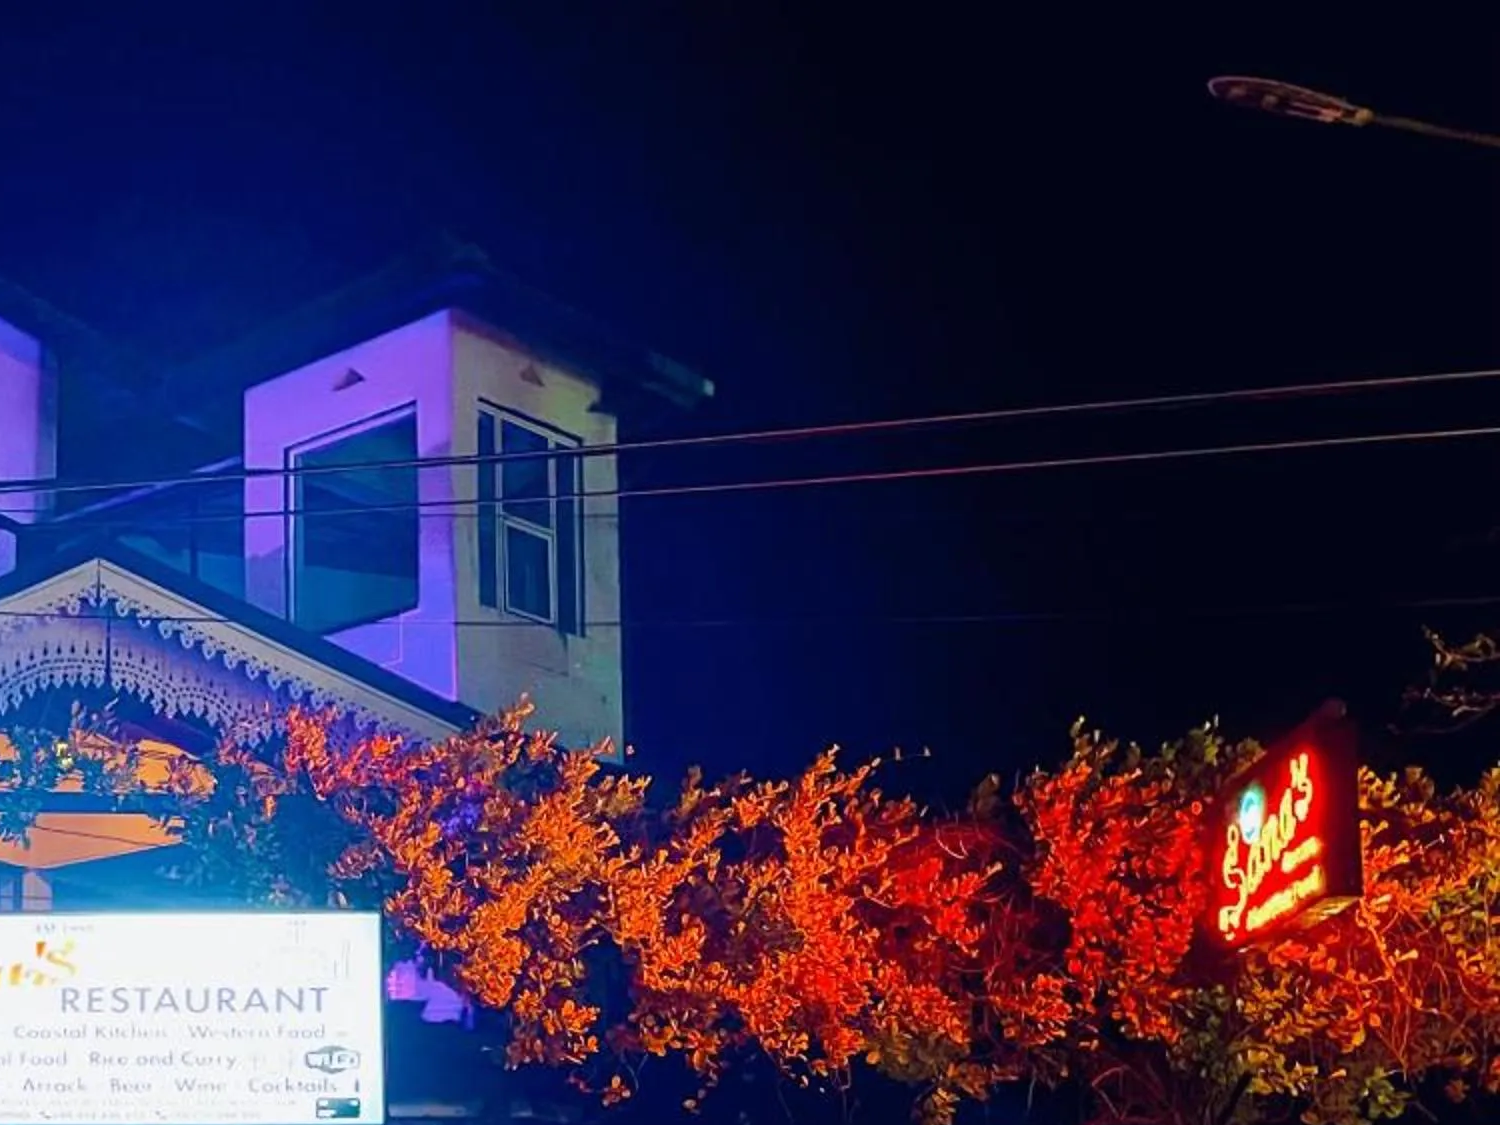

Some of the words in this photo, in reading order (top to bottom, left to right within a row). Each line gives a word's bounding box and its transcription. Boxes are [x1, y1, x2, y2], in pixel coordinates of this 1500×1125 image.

[61, 986, 330, 1014] RESTAURANT
[13, 1025, 88, 1041] Coastal
[136, 1051, 174, 1067] and
